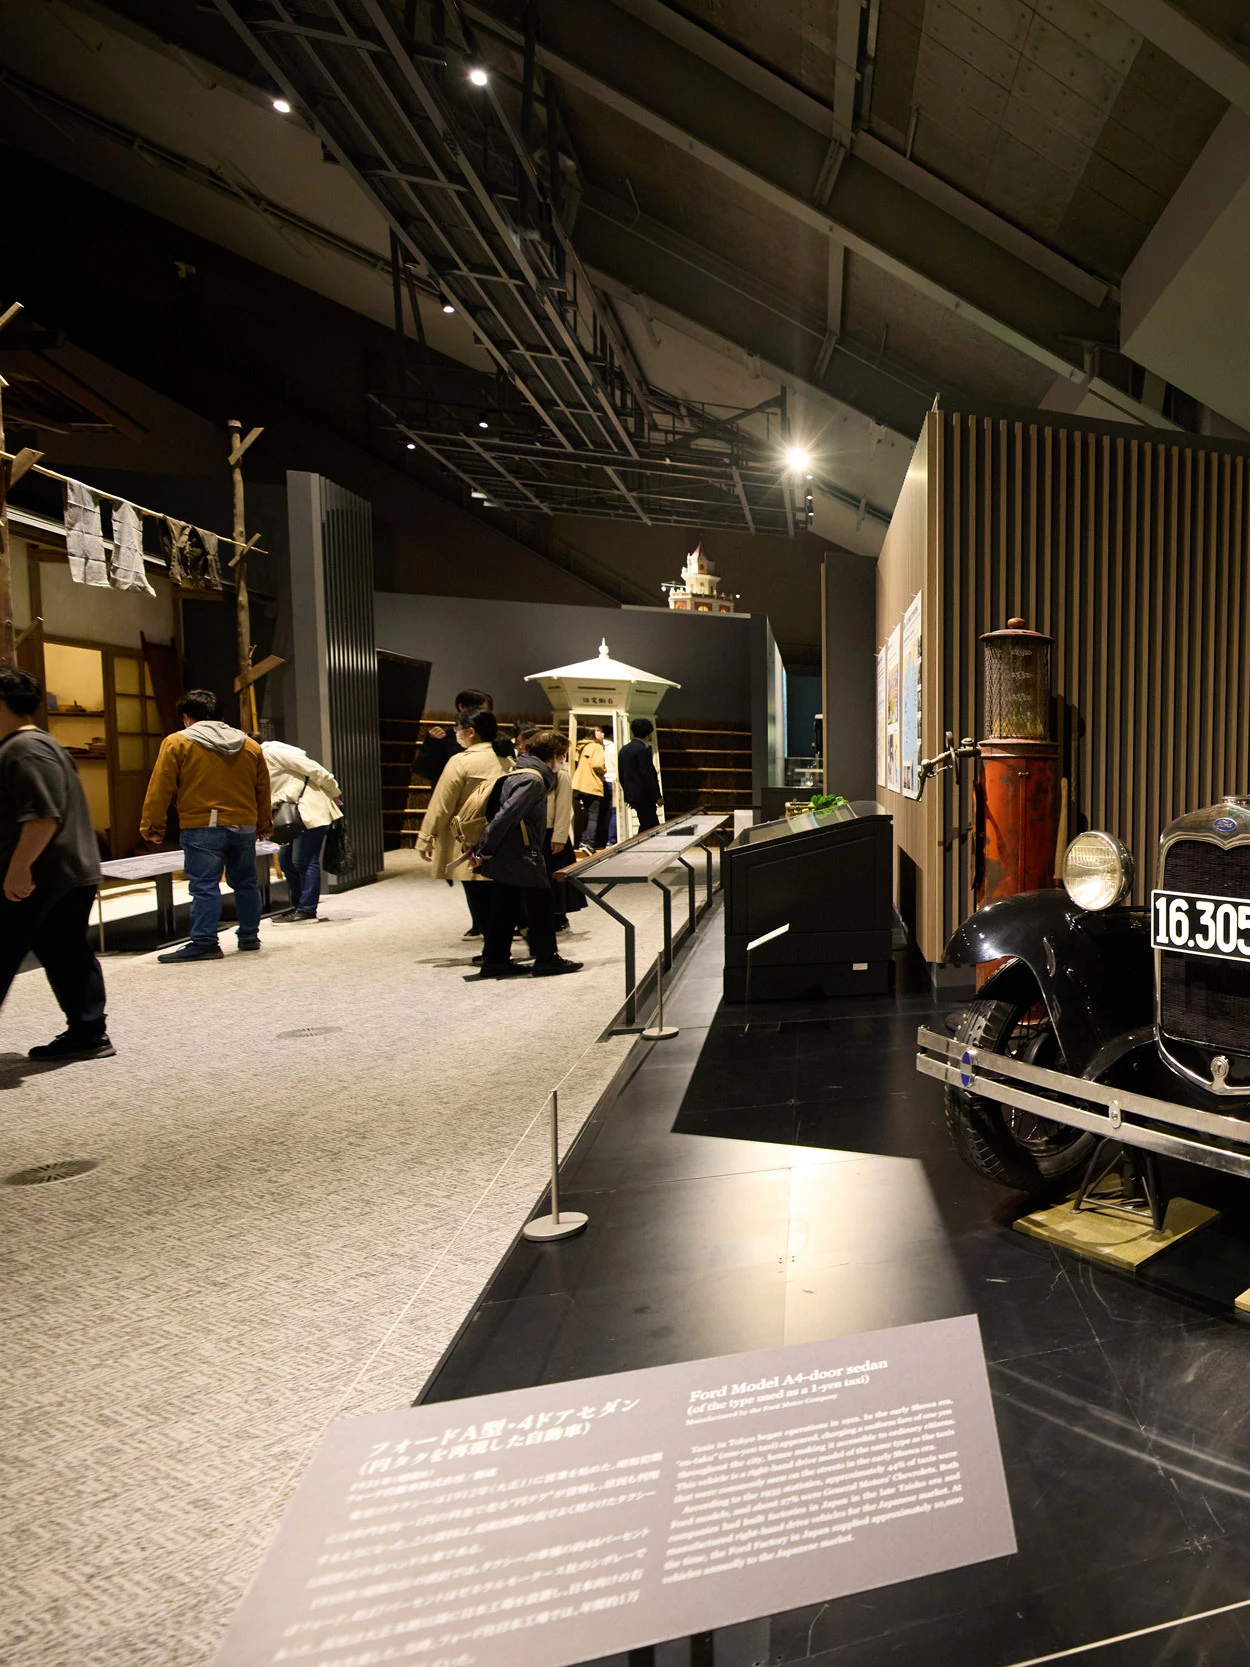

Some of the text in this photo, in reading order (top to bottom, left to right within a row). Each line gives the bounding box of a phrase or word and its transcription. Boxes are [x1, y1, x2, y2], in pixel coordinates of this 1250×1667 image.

[687, 1404, 706, 1417] (of
[707, 1400, 727, 1411] the
[729, 1396, 755, 1410] type
[757, 1389, 784, 1402] used
[786, 1388, 799, 1398] as
[811, 1379, 842, 1393] 1-yen
[844, 1374, 870, 1388] taxi)
[689, 1384, 728, 1402] Ford
[730, 1376, 779, 1396] Model
[847, 1359, 888, 1375] sedan
[763, 1403, 780, 1412] Ford
